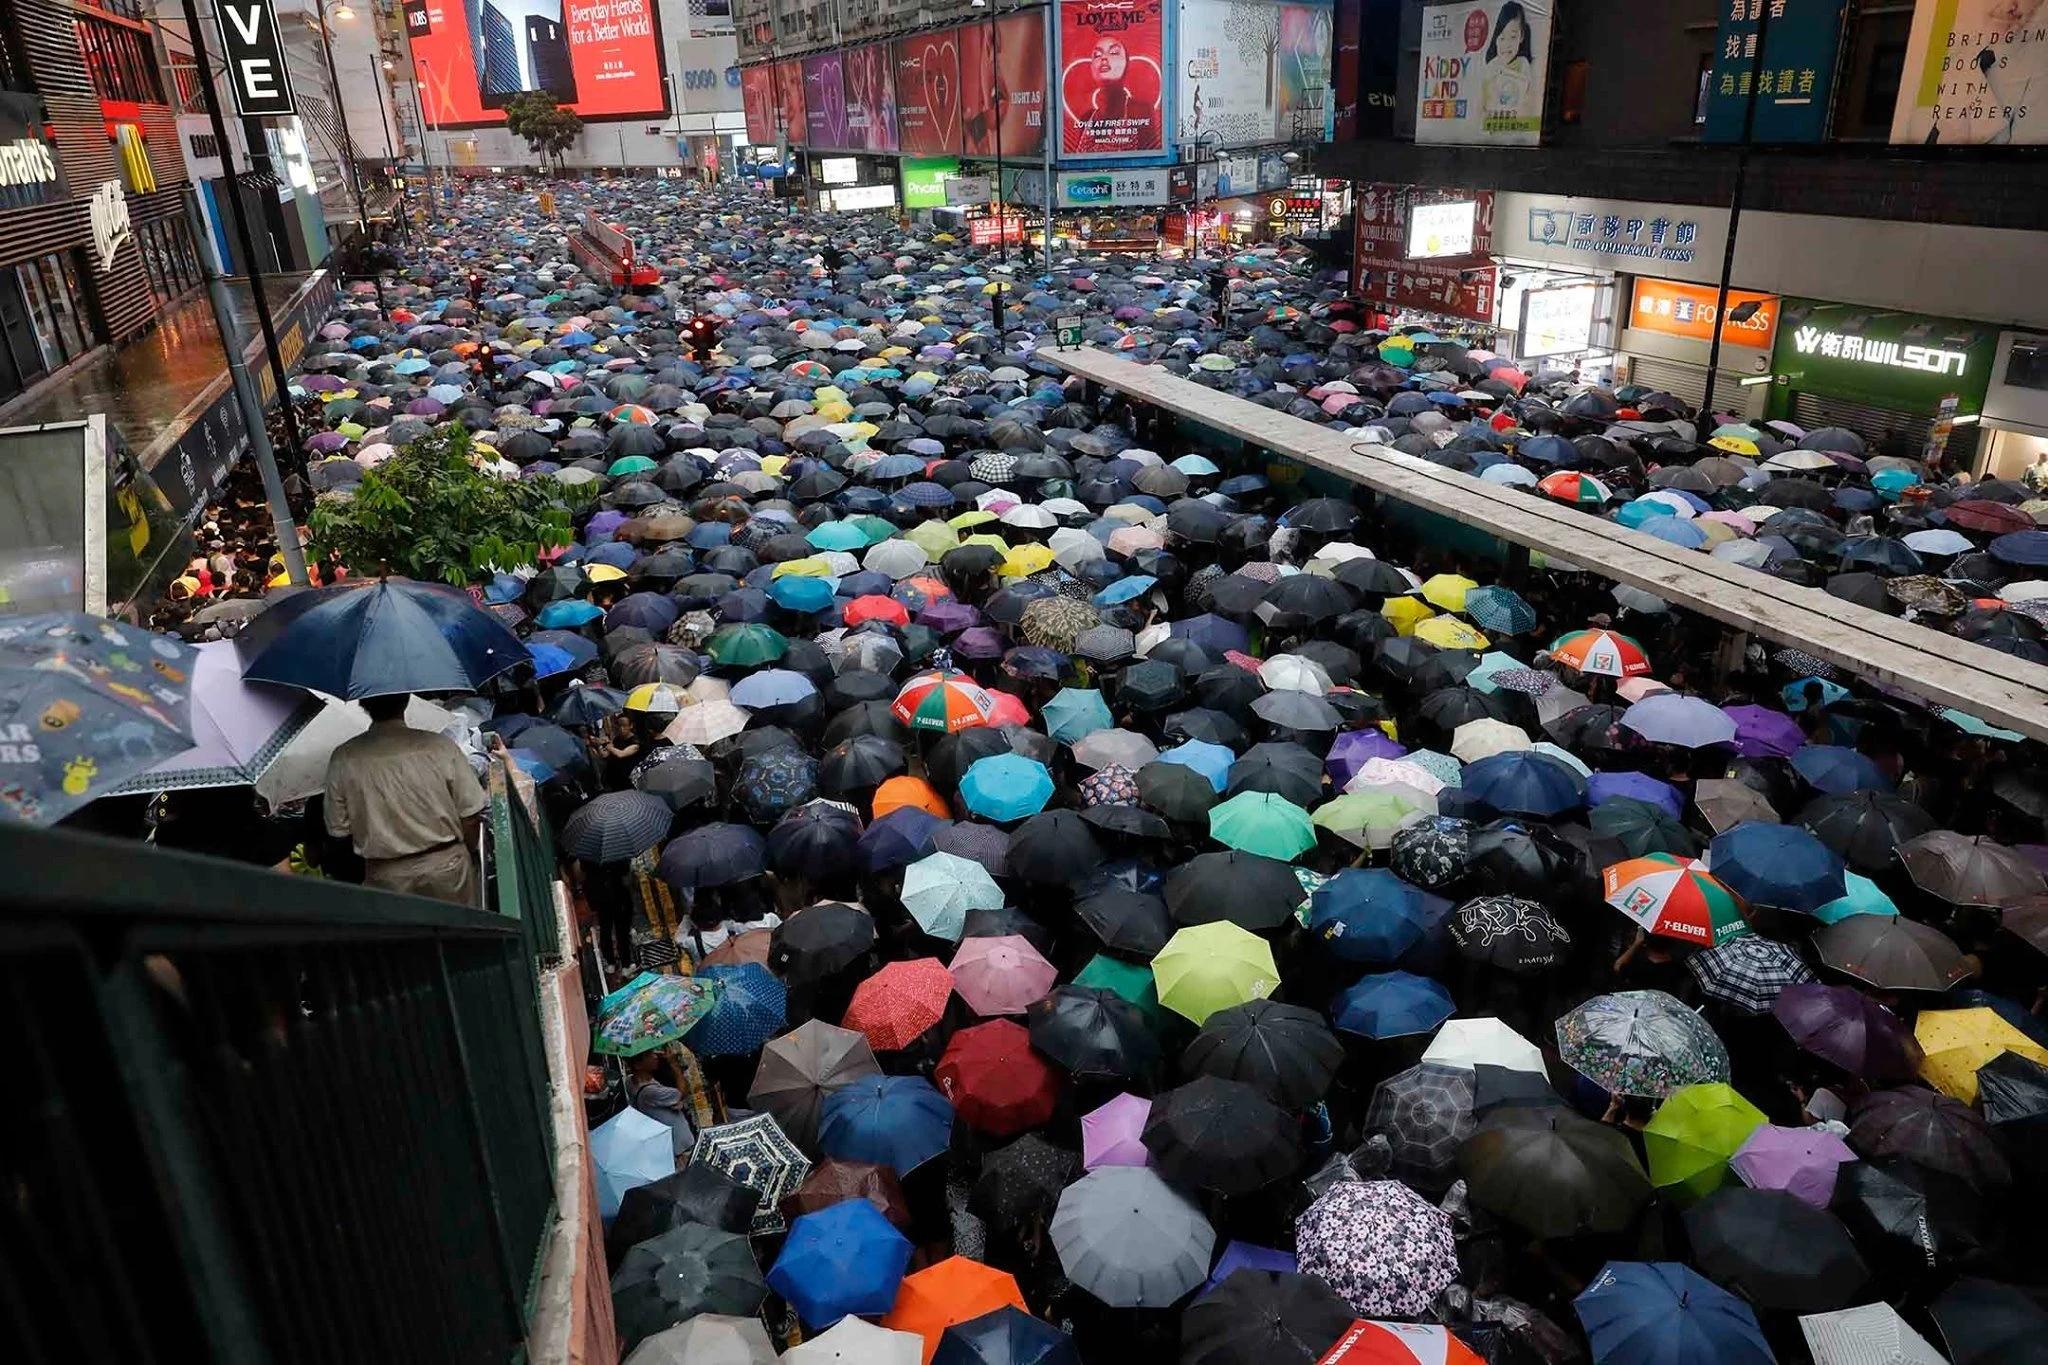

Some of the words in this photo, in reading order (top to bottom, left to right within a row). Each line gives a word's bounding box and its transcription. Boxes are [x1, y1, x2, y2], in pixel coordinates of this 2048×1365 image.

[571, 4, 609, 24] Everyday
[610, 0, 643, 17] Heroes
[1076, 12, 1120, 25] LOVE
[1121, 11, 1146, 23] ME
[571, 25, 584, 45] for
[586, 29, 593, 43] a
[593, 22, 619, 41] Better
[620, 13, 650, 37] World
[1724, 33, 1758, 59] 找書
[1941, 56, 2008, 72] BOOS
[1423, 81, 1459, 99] LAND
[1720, 68, 1816, 95] 為書找讀者
[1936, 82, 1988, 96] WITH
[1011, 92, 1029, 104] LIGHT
[1031, 90, 1040, 103] AS
[1025, 111, 1041, 126] AIR
[1932, 104, 2028, 120] READERS
[1074, 121, 1093, 129] LOVE
[1576, 213, 1696, 246] 商務印書館
[1573, 238, 1591, 251] THE
[1594, 242, 1657, 259] COMMERCIAL
[1660, 249, 1696, 263] PRESS
